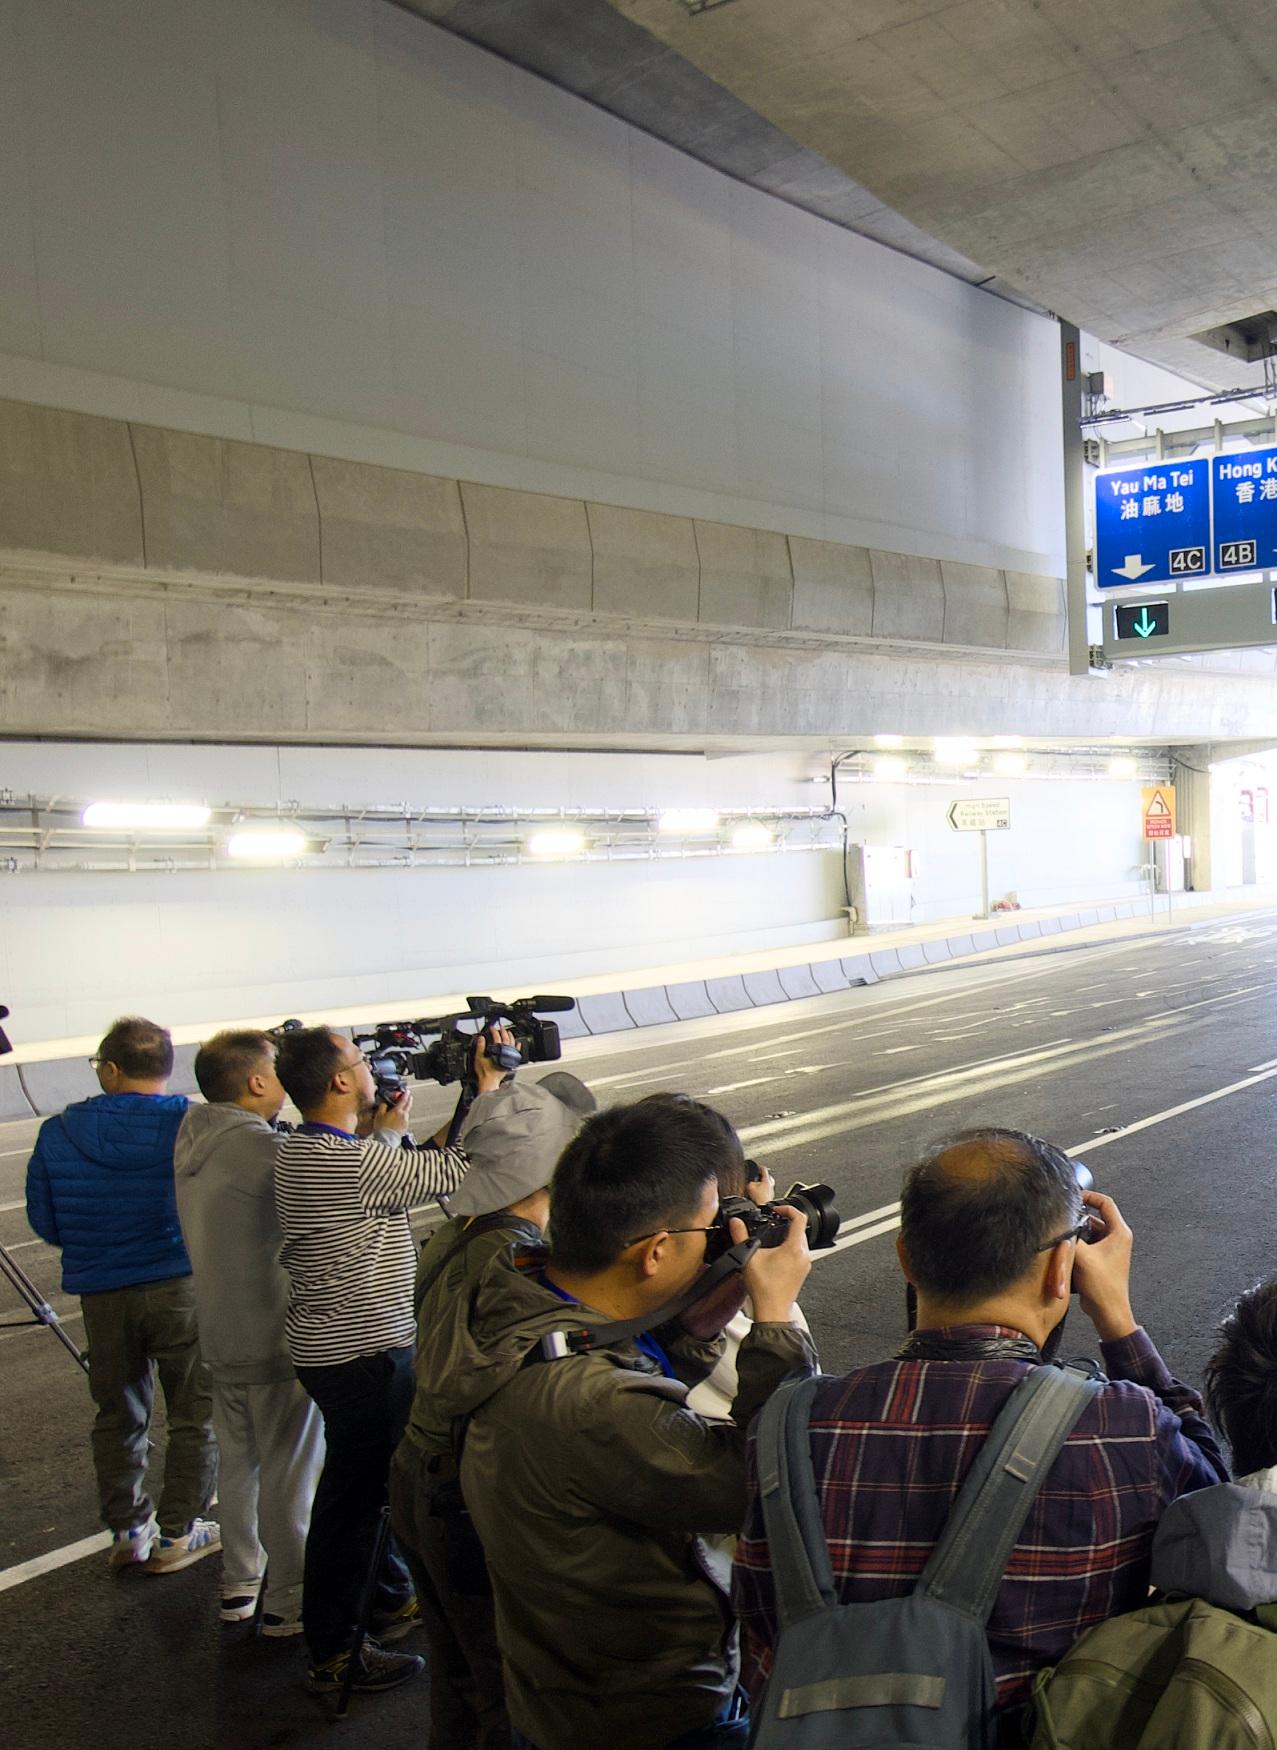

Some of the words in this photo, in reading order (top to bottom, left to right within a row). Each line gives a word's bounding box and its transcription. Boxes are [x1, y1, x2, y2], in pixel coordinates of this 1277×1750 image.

[1219, 462, 1262, 480] Hong
[1110, 479, 1139, 497] Yau
[1143, 474, 1166, 491] Ma
[1169, 470, 1194, 488] Tei
[1120, 492, 1185, 520] 油麻地
[1172, 549, 1201, 571] 4C
[1222, 544, 1253, 565] 4B
